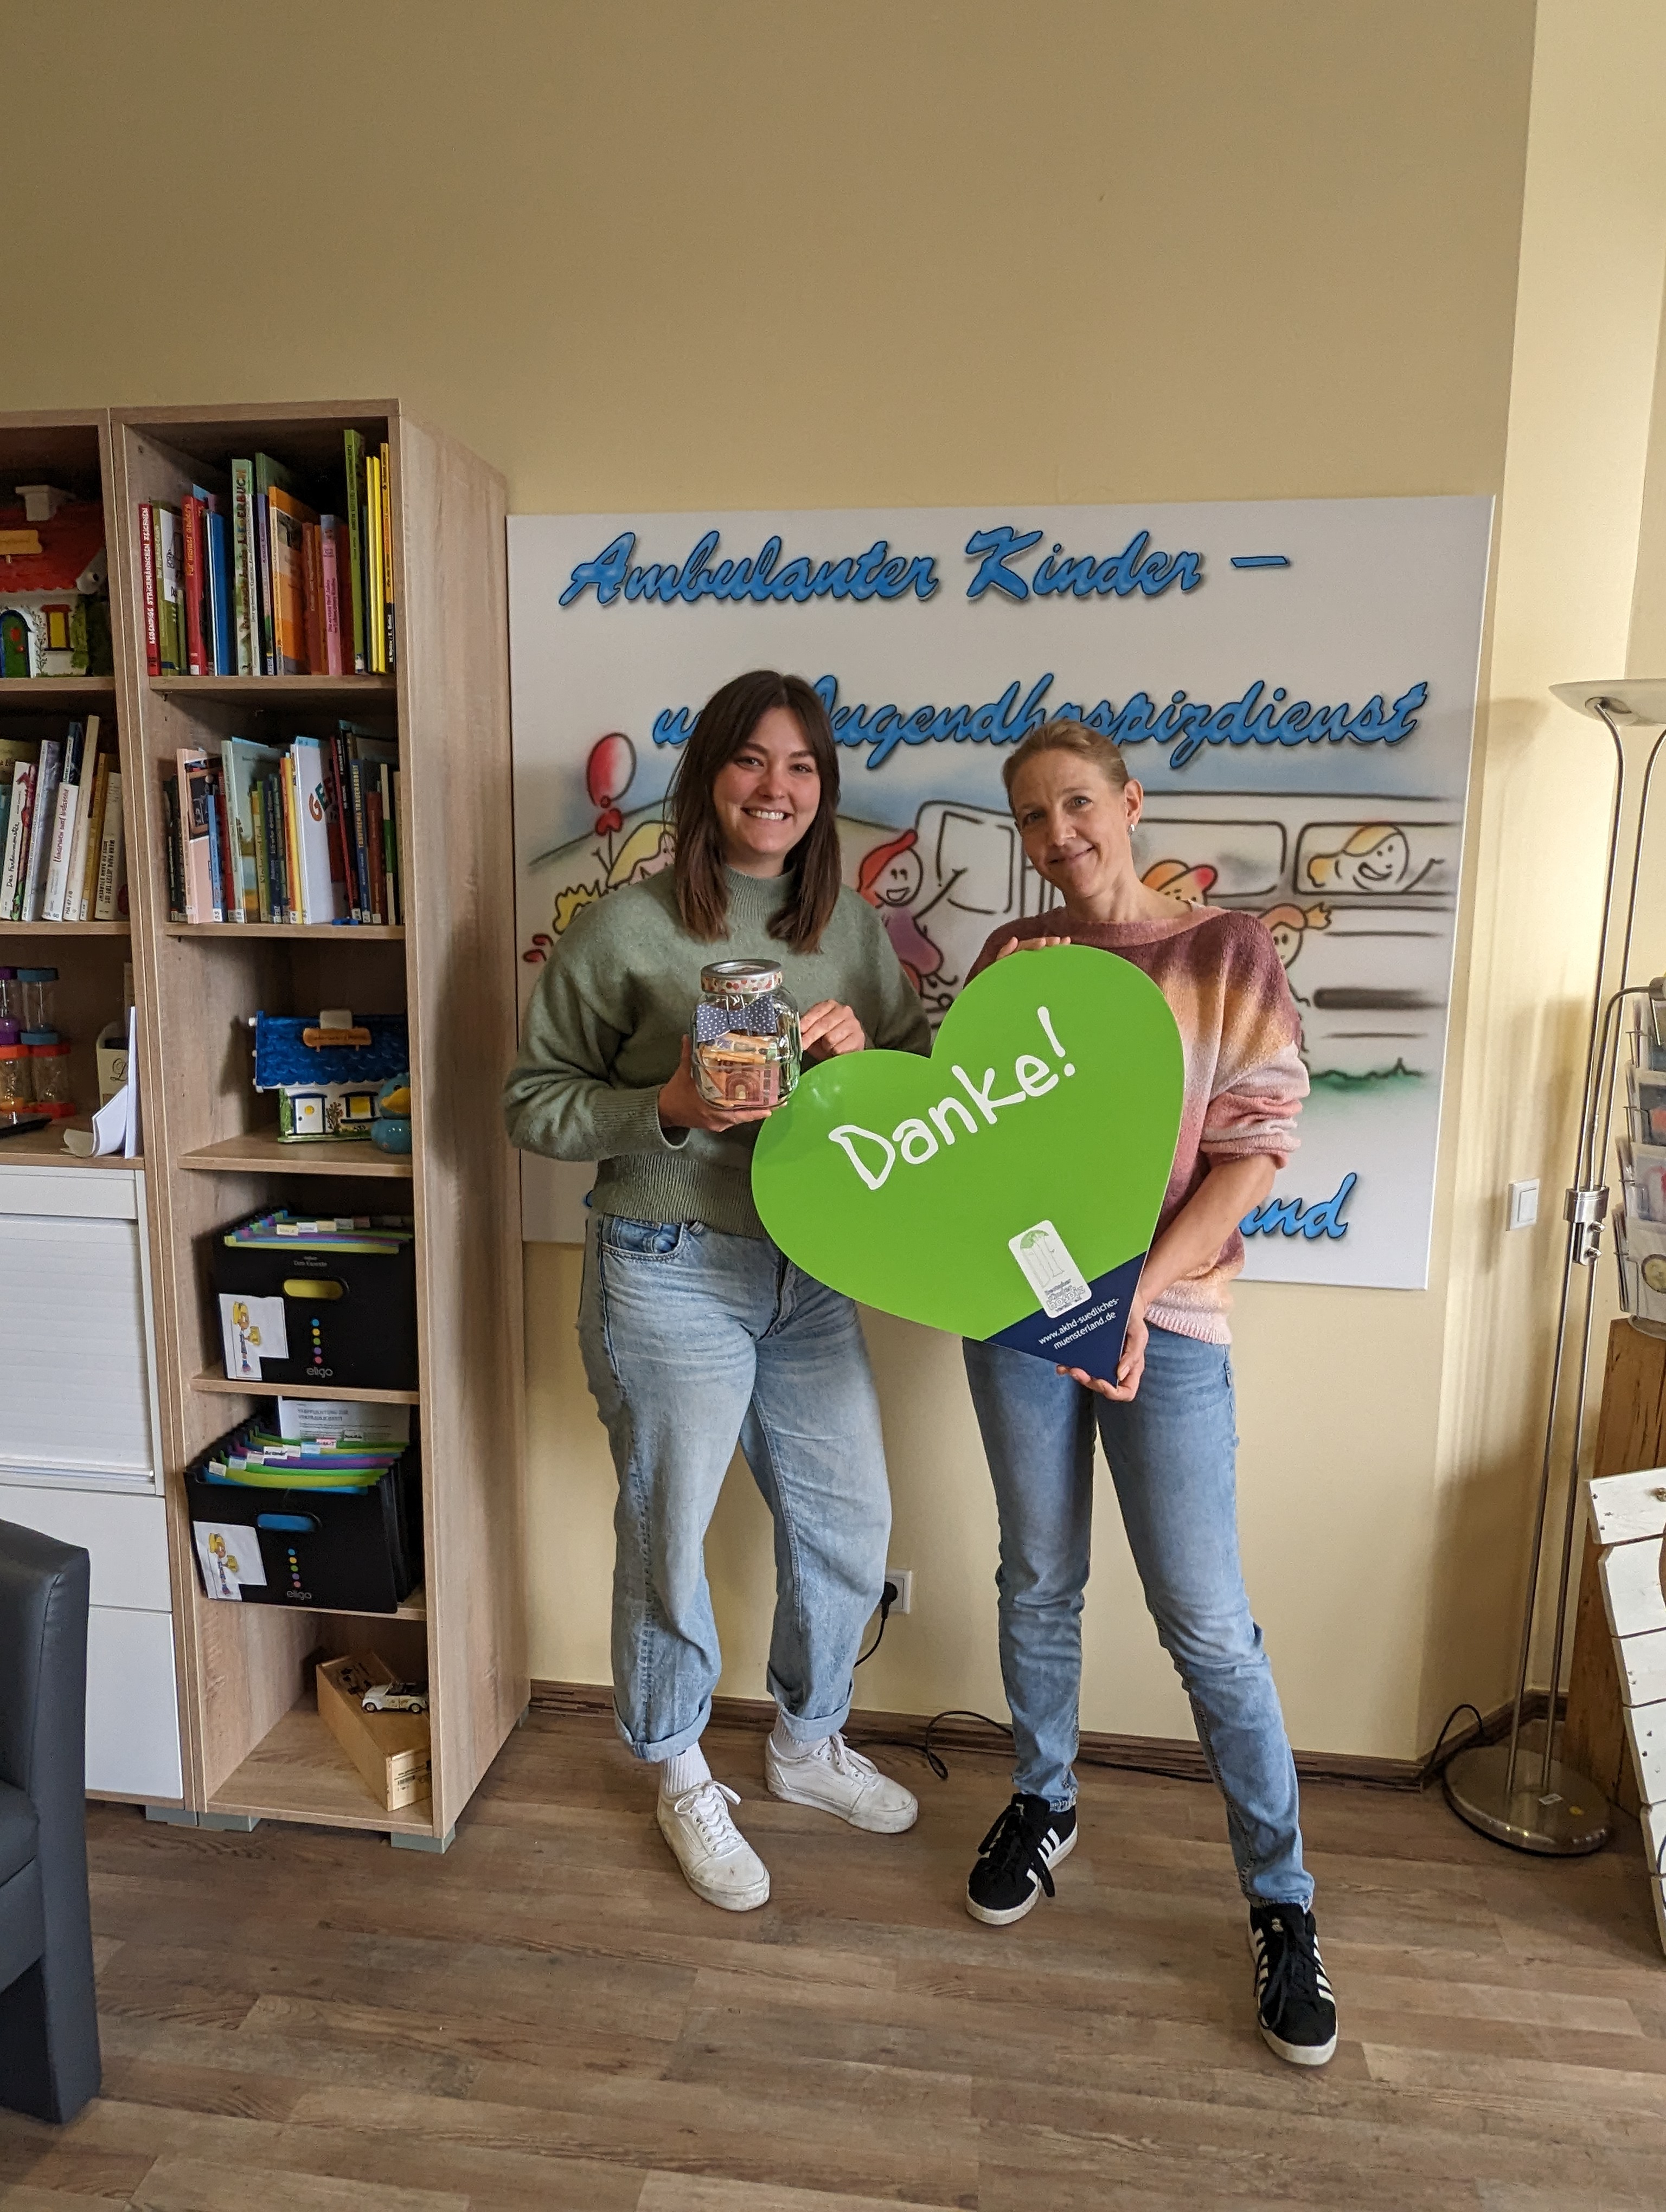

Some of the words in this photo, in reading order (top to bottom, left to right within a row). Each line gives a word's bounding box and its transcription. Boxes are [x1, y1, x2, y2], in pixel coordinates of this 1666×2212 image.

[559, 531, 939, 606] Ambulanter
[965, 526, 1202, 601] Kinder
[829, 1006, 1075, 1190] Danke!
[1047, 1285, 1086, 1311] hospiz
[1053, 1311, 1117, 1350] muensterland.de
[306, 1366, 334, 1378] eligo
